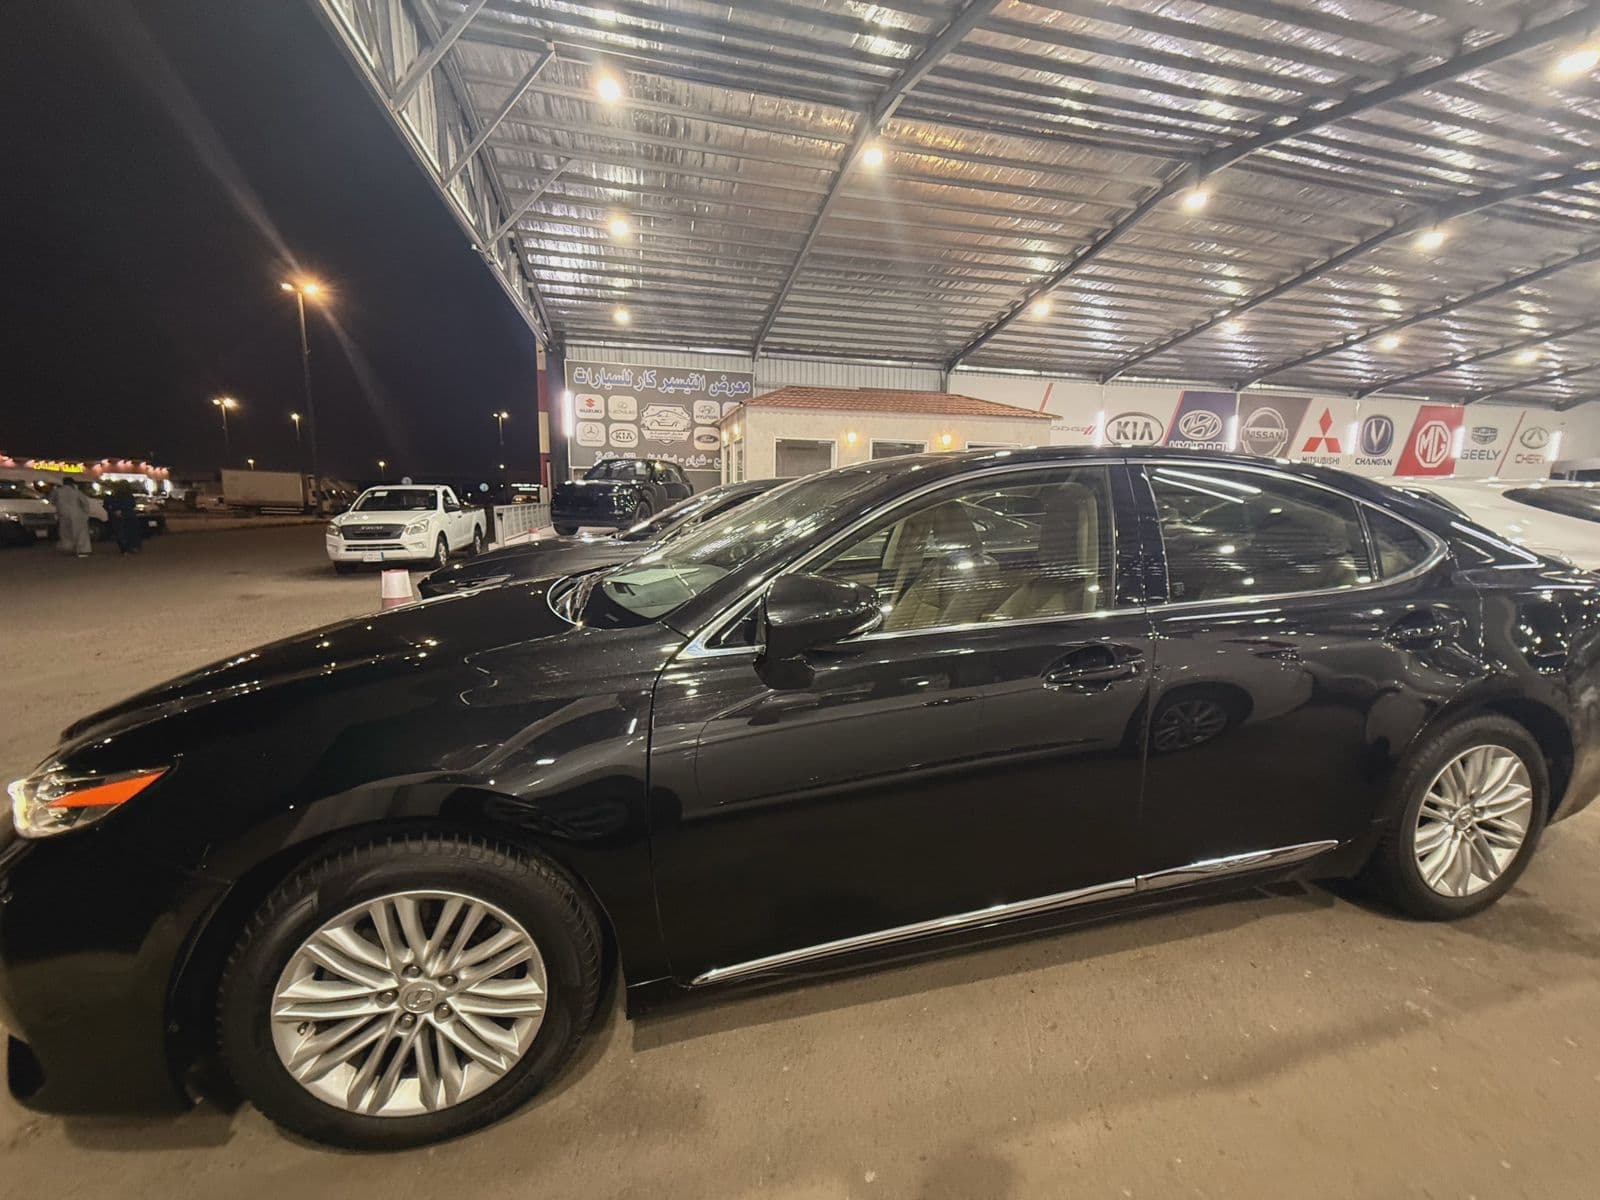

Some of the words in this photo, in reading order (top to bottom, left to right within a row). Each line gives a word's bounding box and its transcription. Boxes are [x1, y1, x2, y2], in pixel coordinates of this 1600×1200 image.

[574, 367, 633, 389] للسيارات
[633, 370, 656, 391] كار
[709, 374, 750, 397] معرض
[615, 432, 633, 440] KIA
[1115, 421, 1153, 441] KIA
[1245, 430, 1283, 441] NISSAN
[1419, 425, 1447, 463] MG
[1302, 456, 1340, 465] MITSUBISHI
[1355, 458, 1393, 466] CHANGAN
[1461, 449, 1501, 460] GEELY
